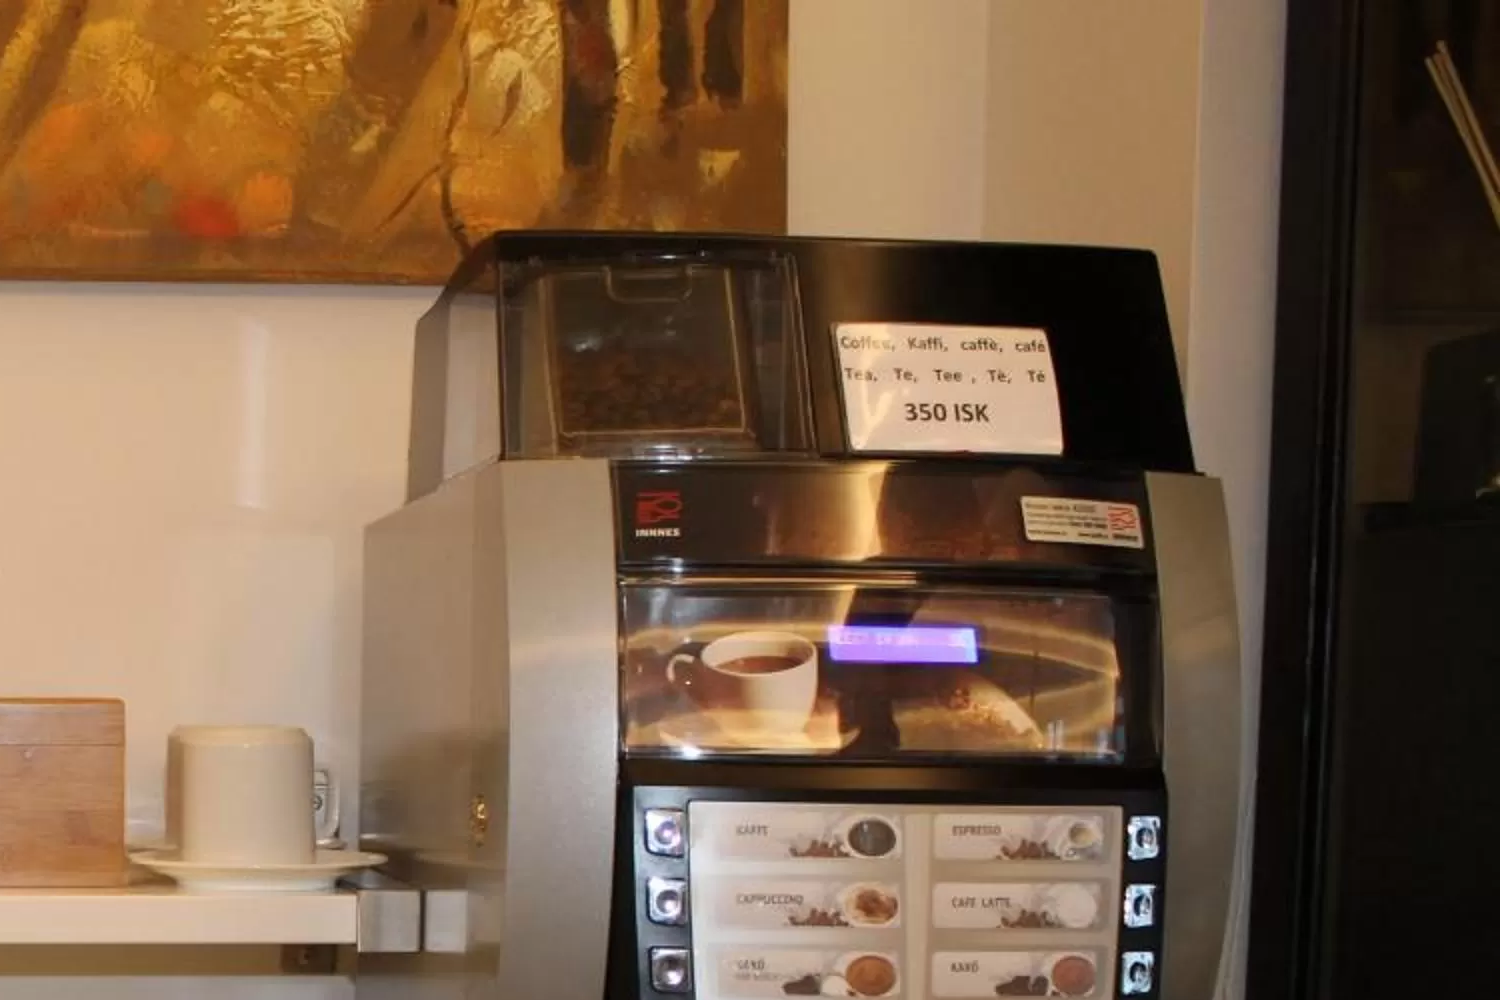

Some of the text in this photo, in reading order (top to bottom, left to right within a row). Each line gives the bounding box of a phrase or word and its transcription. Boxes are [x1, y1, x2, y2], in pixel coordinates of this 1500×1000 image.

[908, 336, 948, 352] Kaffi,
[844, 367, 878, 383] Tea,
[894, 367, 917, 384] Te,
[903, 403, 989, 422] 350 ISK
[951, 825, 1002, 837] ESPRESSO
[735, 893, 805, 906] CAPPUCCINO
